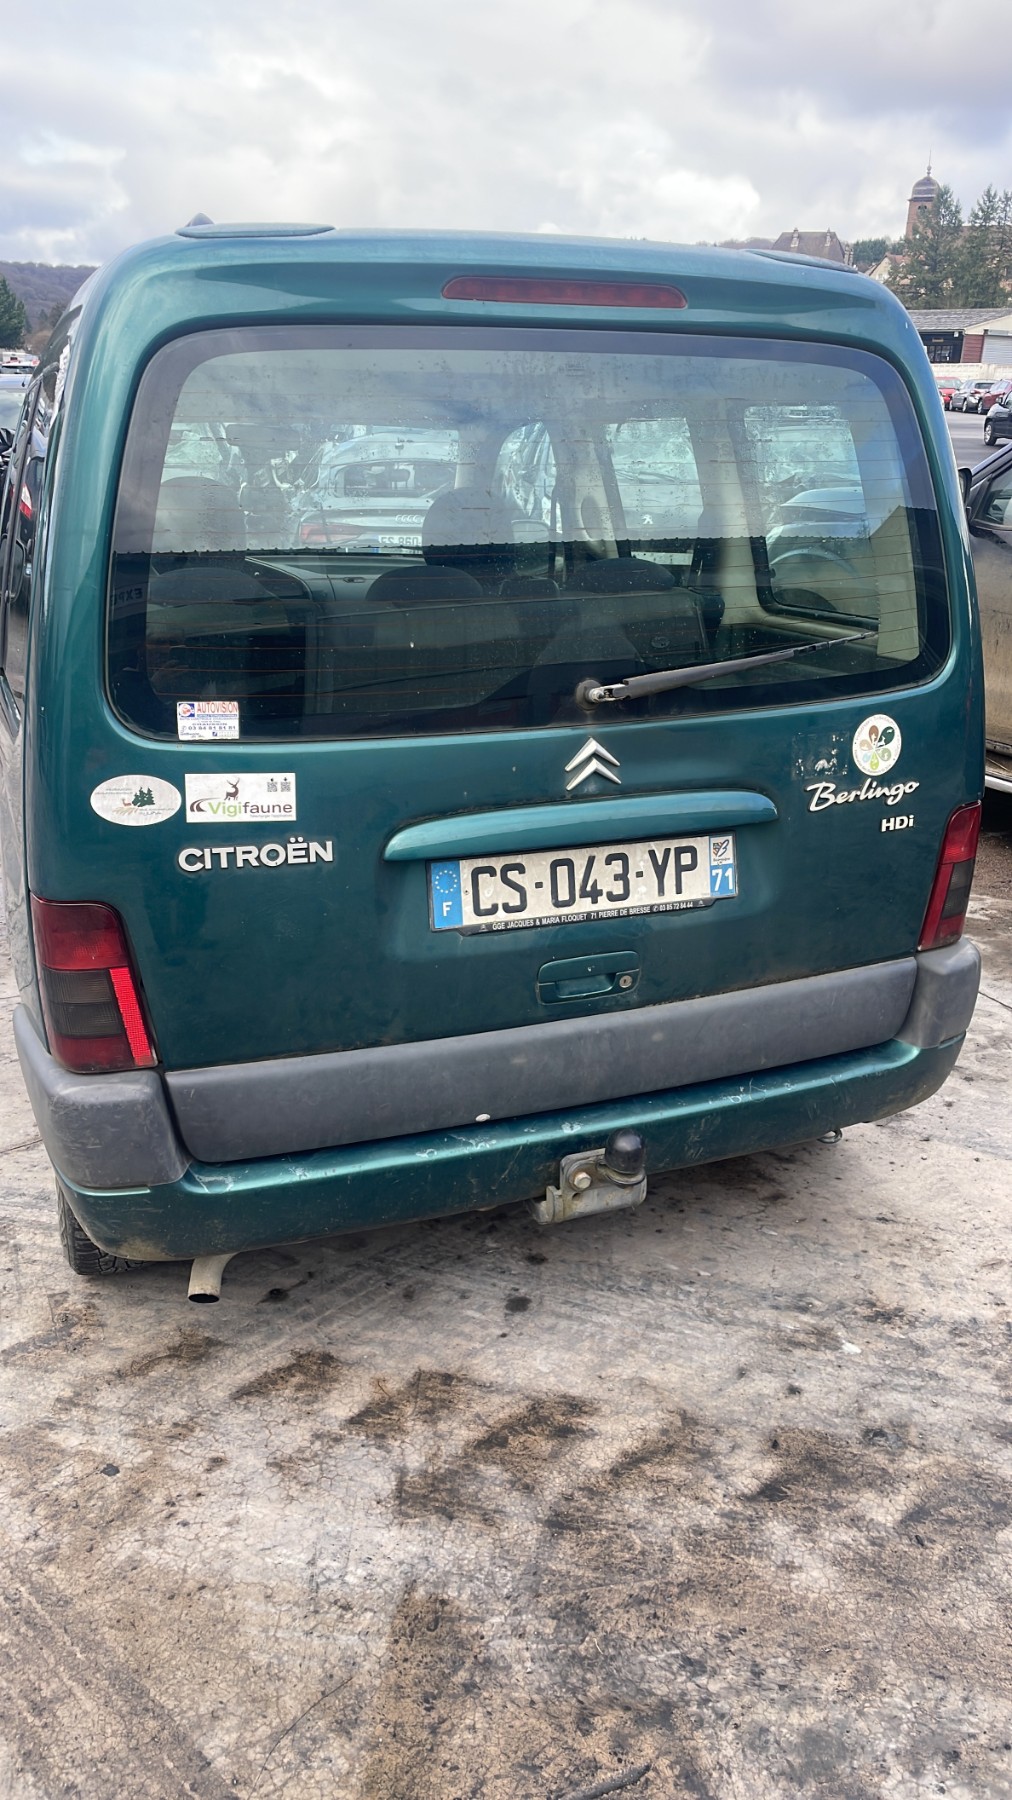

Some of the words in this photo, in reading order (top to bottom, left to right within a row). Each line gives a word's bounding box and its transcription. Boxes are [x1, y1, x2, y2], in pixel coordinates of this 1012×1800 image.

[197, 702, 238, 714] AUTOVISION
[806, 778, 920, 811] Berlingo
[208, 801, 293, 817] Vigifaune
[881, 815, 914, 832] HDi
[178, 836, 334, 872] CITROËN
[470, 845, 698, 917] CS-043-YP
[711, 867, 733, 892] 71
[442, 901, 453, 917] F
[507, 920, 534, 929] JACQUES
[535, 918, 540, 926] &
[541, 916, 560, 925] MARIA
[561, 913, 588, 923] FLOQUET
[598, 910, 619, 919] PIERRE
[629, 906, 651, 915] BRESSE
